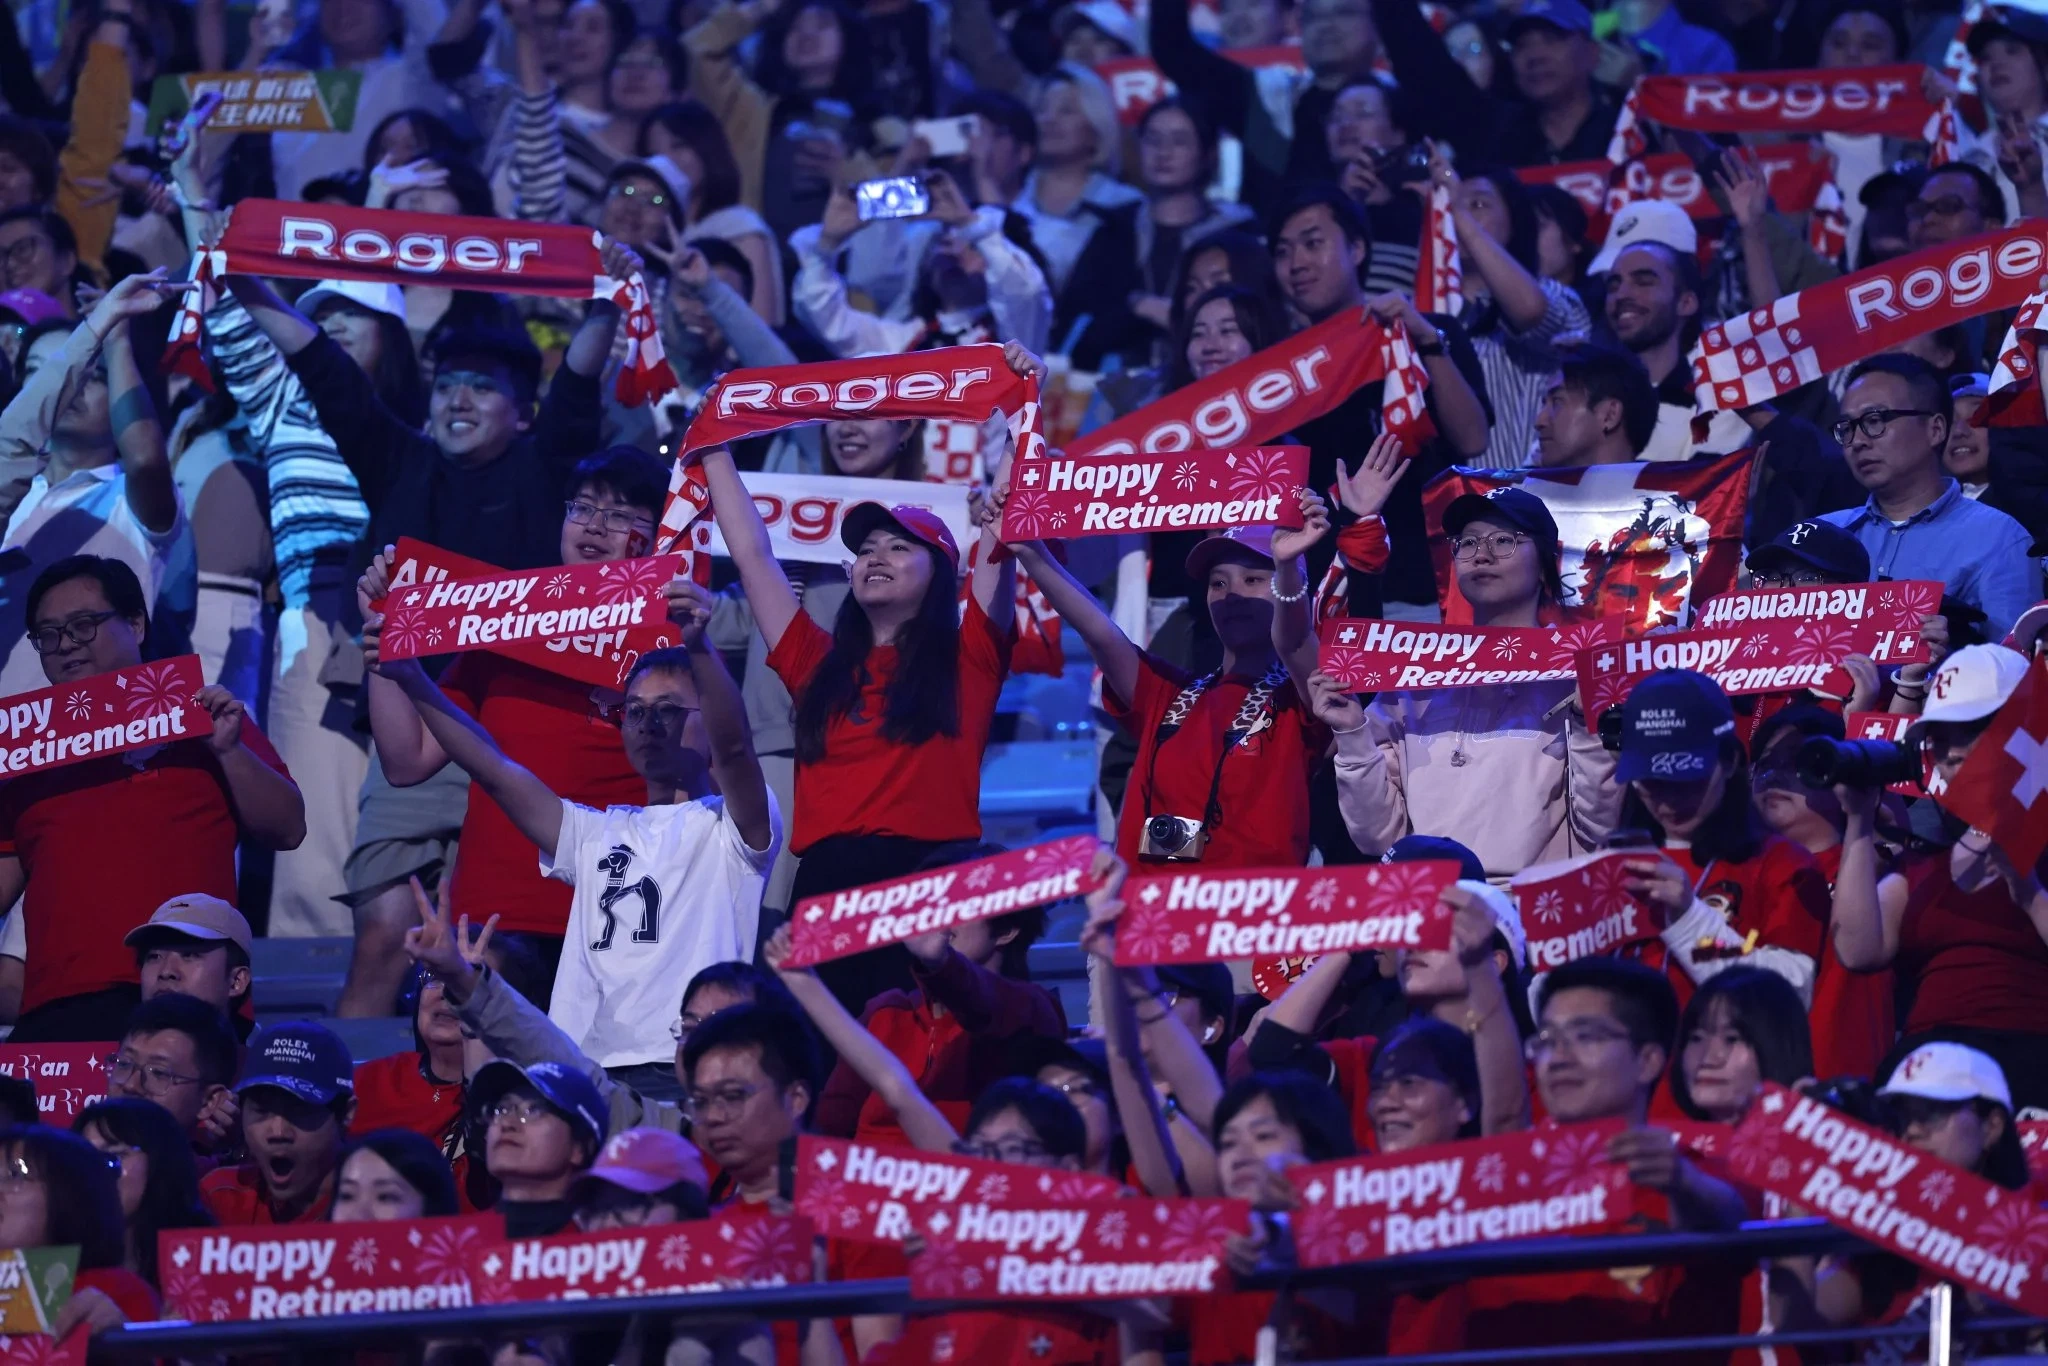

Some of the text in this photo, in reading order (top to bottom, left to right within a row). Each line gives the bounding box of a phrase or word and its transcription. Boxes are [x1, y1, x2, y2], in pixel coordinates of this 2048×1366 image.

[1683, 78, 1906, 119] Roger
[279, 216, 541, 275] Roger
[1845, 236, 2048, 333] Roge
[716, 367, 991, 419] Roger
[1047, 460, 1164, 498] Happy
[1082, 494, 1283, 531] Retirement
[424, 576, 539, 611] Happy
[1702, 588, 1867, 627] Retirement
[456, 596, 647, 646] Retirement
[1364, 623, 1486, 663] Happy
[1625, 636, 1742, 674] Happy
[1635, 718, 1686, 730] SHANGHAI
[830, 871, 957, 921] Happy
[866, 867, 1083, 945] Retirement
[1167, 874, 1298, 917] Happy
[1206, 910, 1424, 957] Retirement
[264, 1046, 316, 1062] SHANGHAI
[273, 1038, 309, 1051] ROLEX
[1782, 1096, 1920, 1189] Happy
[844, 1145, 972, 1202] Happy
[1334, 1157, 1464, 1210] Happy
[955, 1203, 1089, 1252] Happy
[1384, 1184, 1608, 1255] Retirement
[1801, 1164, 2031, 1300] Retirement
[200, 1236, 337, 1282] Happy
[511, 1237, 647, 1285] Happy
[998, 1249, 1220, 1296] Retirement
